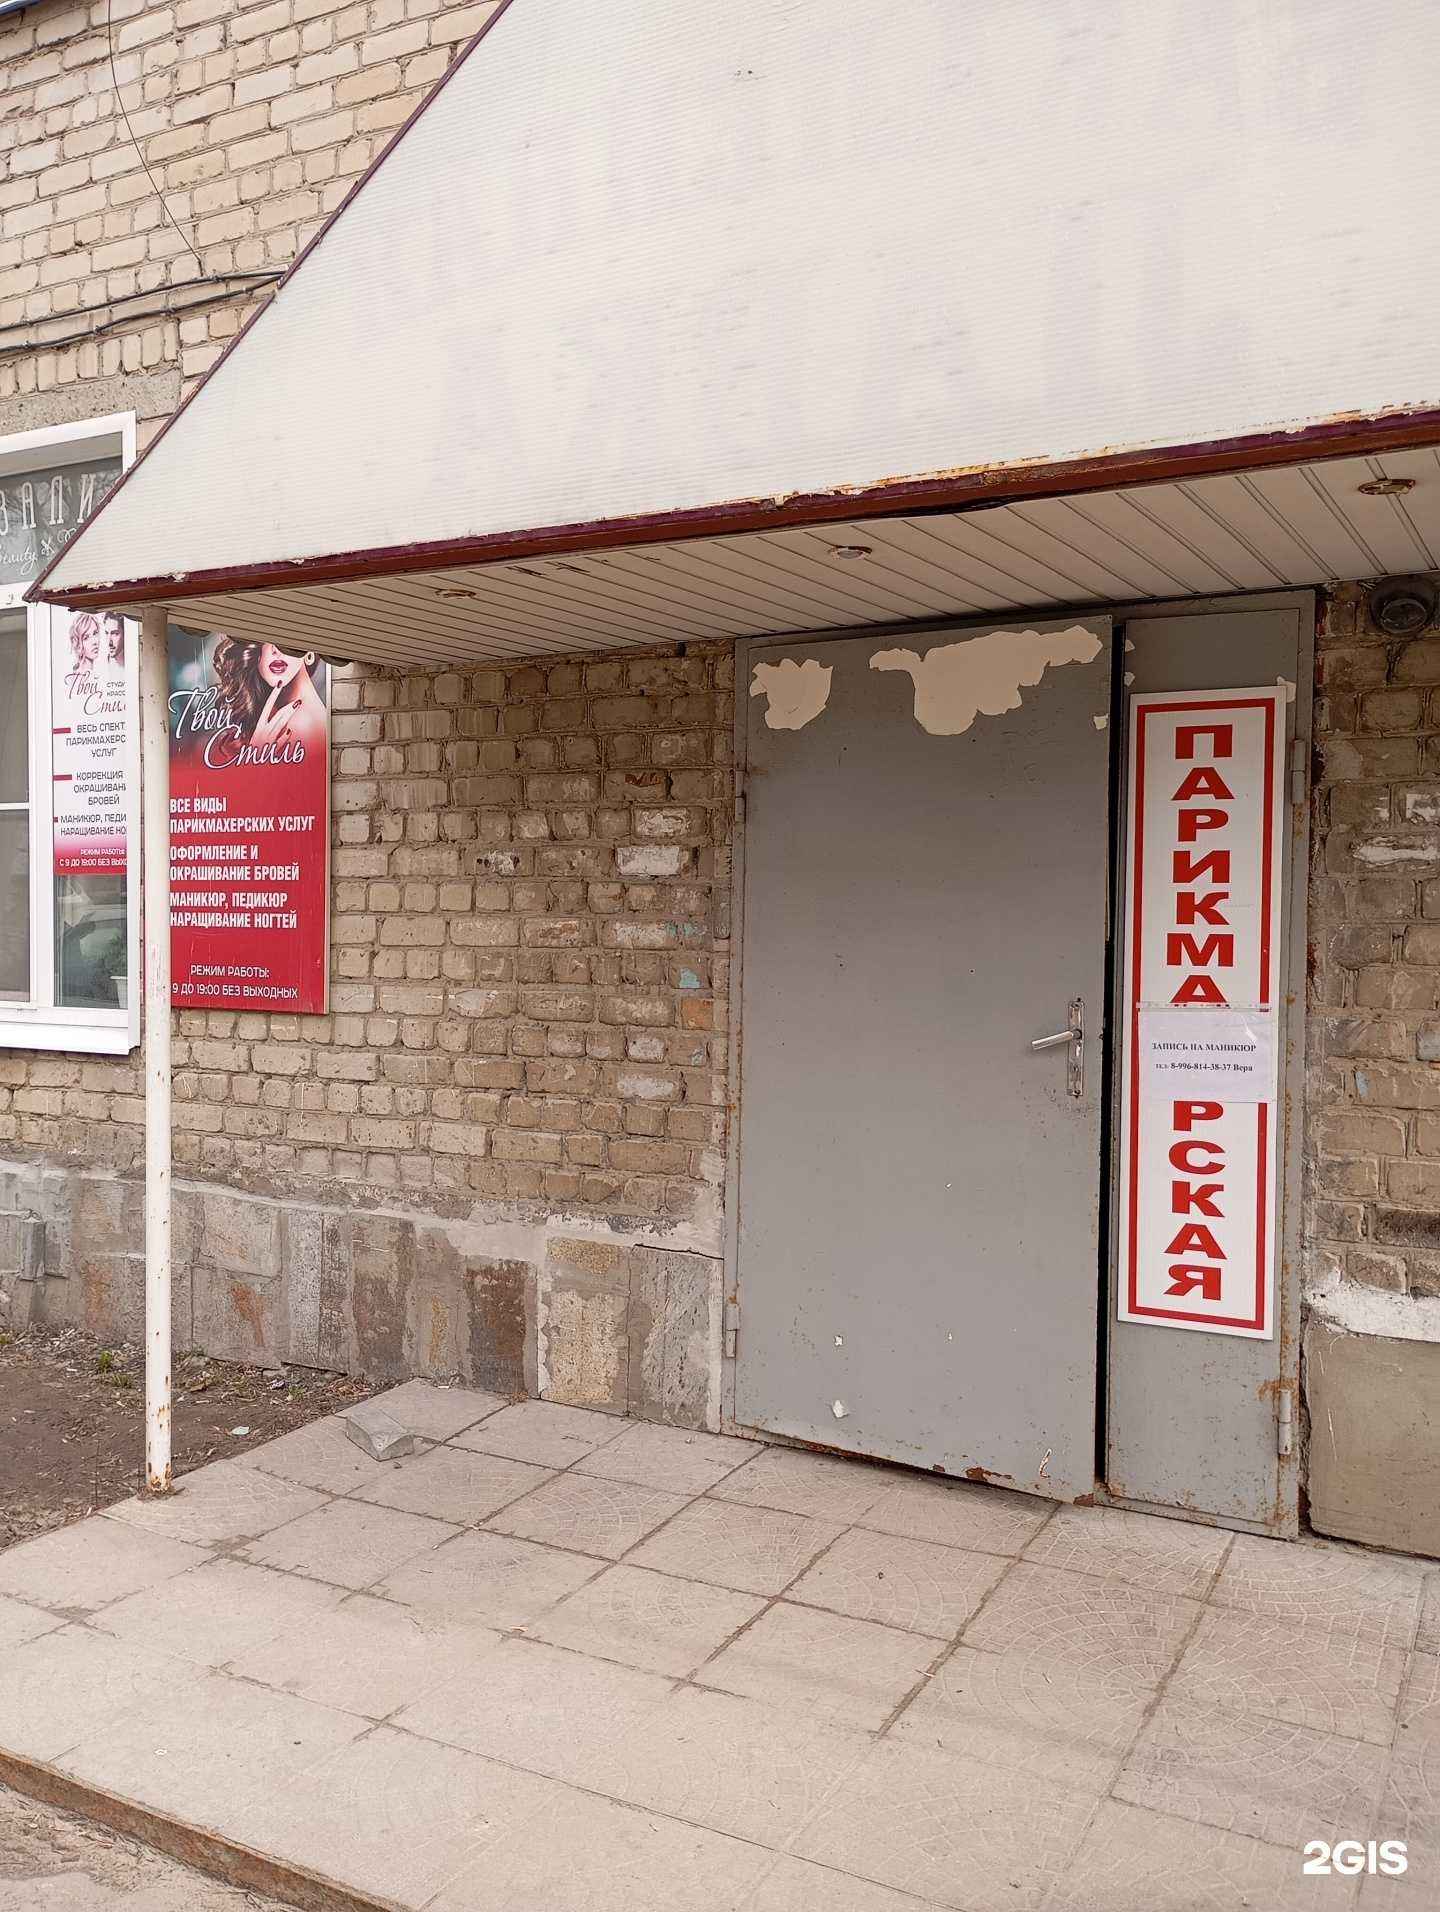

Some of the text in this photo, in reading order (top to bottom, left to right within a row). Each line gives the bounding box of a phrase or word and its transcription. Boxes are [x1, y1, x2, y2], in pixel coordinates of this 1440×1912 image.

[0, 544, 37, 576] eauty
[65, 671, 99, 699] Твой
[168, 686, 235, 739] Твой
[77, 723, 98, 733] ВЕСЬ
[66, 734, 126, 746] ПАРИКМАХЕРС
[204, 724, 305, 769] Стиль
[91, 747, 117, 757] УСЛУГ
[76, 770, 124, 780] КОРРЕКЦИЯ
[88, 793, 120, 805] БРОВЕЙ
[170, 797, 226, 814] ВСЕ ВИДЫ
[60, 813, 127, 824] МАНИКЮР, ПЕДИ
[170, 815, 315, 834] ПАРИКМАХЕРСКИХ УСЛУГ
[60, 827, 114, 837] НАРАЩИВАНИЕ
[170, 845, 258, 861] ОФОРМЛЕНИЕ И
[71, 859, 80, 868] ДО
[170, 862, 300, 881] ОКРАШИВАНИЕ БРОВЕЙ
[170, 892, 288, 909] МАНИКЮР, ПЕДИКЮР
[170, 909, 297, 929] НАРАЩИВАНИЕ НОГТЕЙ
[190, 965, 270, 978] РЕЖИМ РАБОТЫ:
[172, 983, 299, 999] 9 ДО 19:00 БЕЗ ВЫХОДНЫХ
[1163, 724, 1236, 1301] ПАРИКМАРСКАЯ
[1152, 1042, 1256, 1052] ЗАПИСЬ НА МАНИКЮР
[1233, 1063, 1253, 1073] Вера
